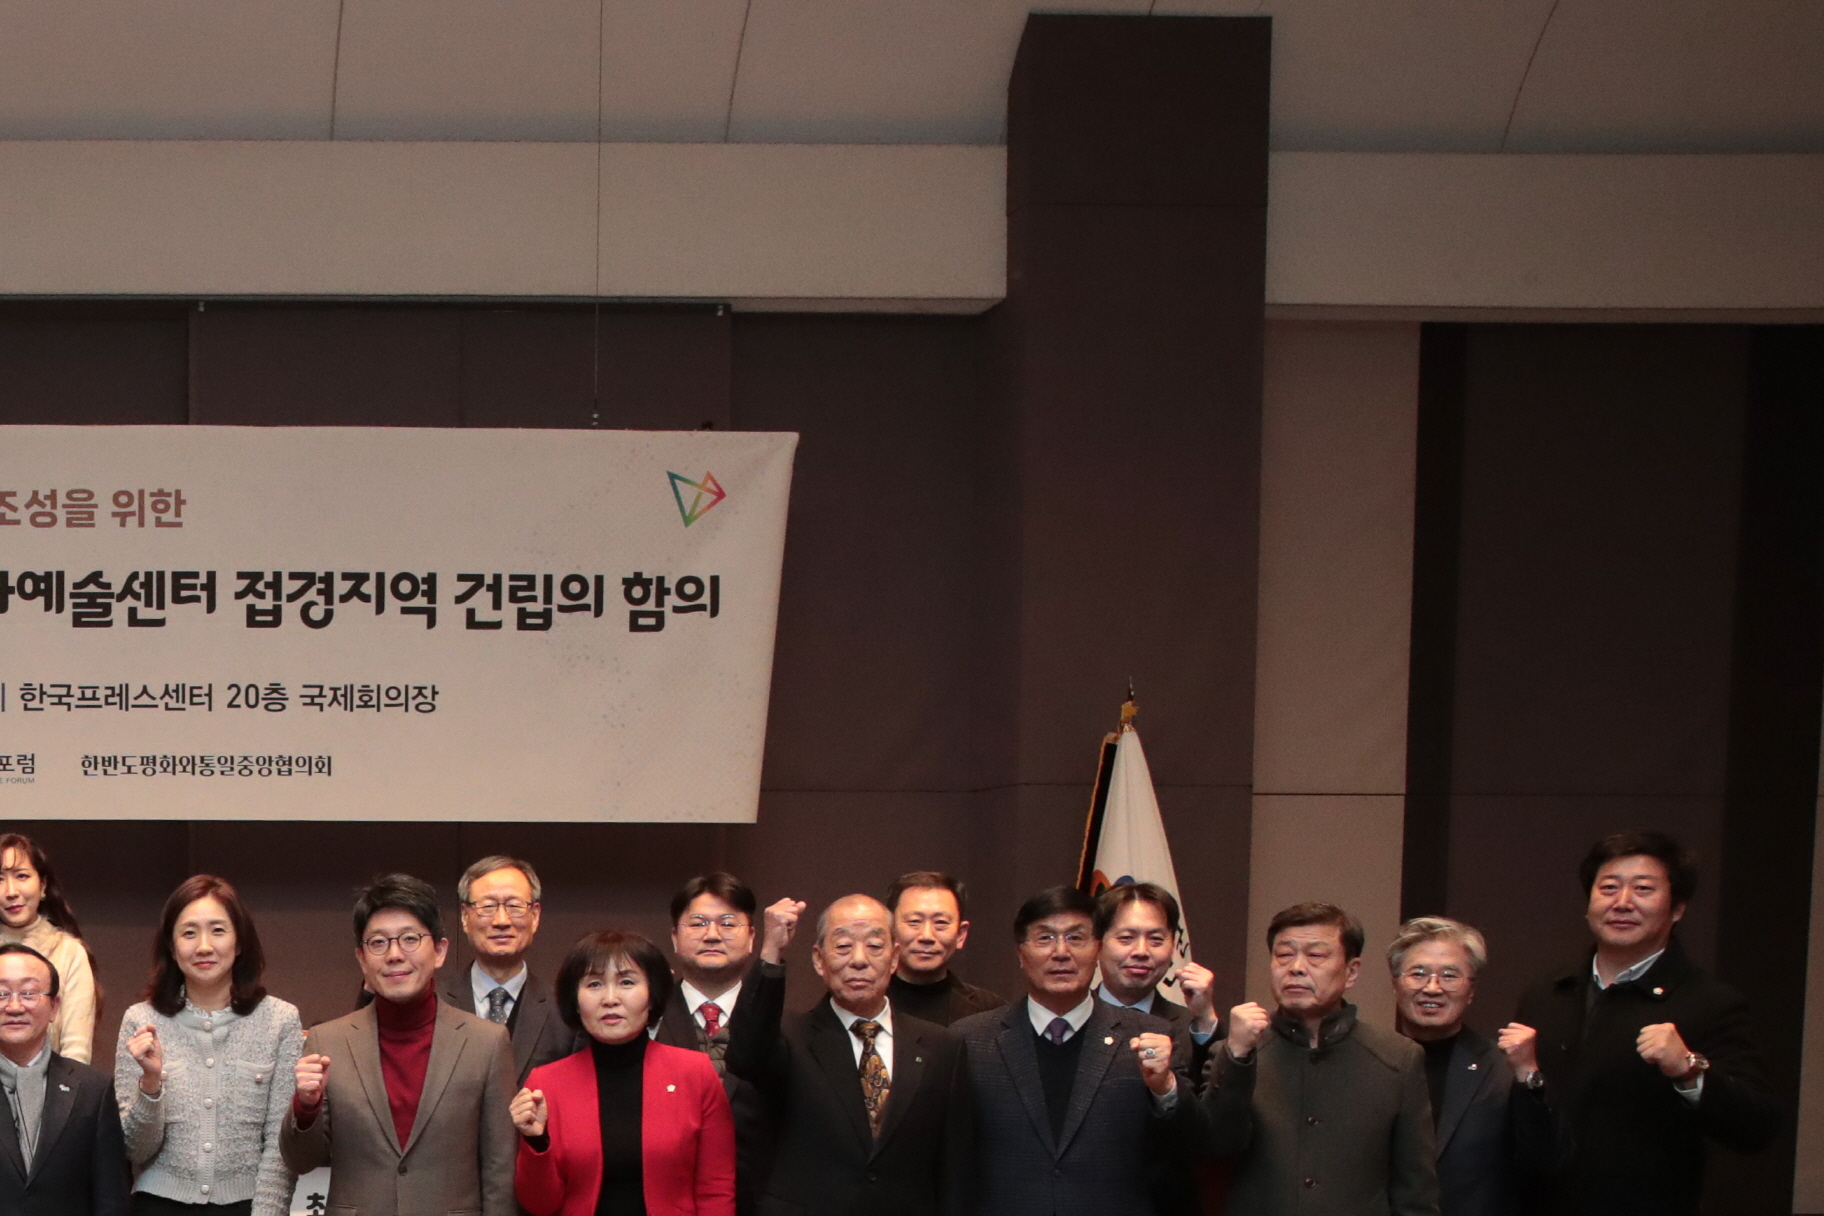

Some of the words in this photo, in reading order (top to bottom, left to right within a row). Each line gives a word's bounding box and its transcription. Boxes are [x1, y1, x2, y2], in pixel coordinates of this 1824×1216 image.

[111, 488, 186, 528] 위한
[234, 570, 437, 630] 접경지역
[454, 573, 604, 632] 건립의
[621, 571, 720, 633] 함의
[19, 682, 213, 712] 한국프레스센터
[227, 682, 289, 713] 20층
[299, 683, 439, 714] 국제회의장
[5, 777, 35, 785] FORUM
[81, 754, 332, 777] 한반도평화와통일중앙협의회
